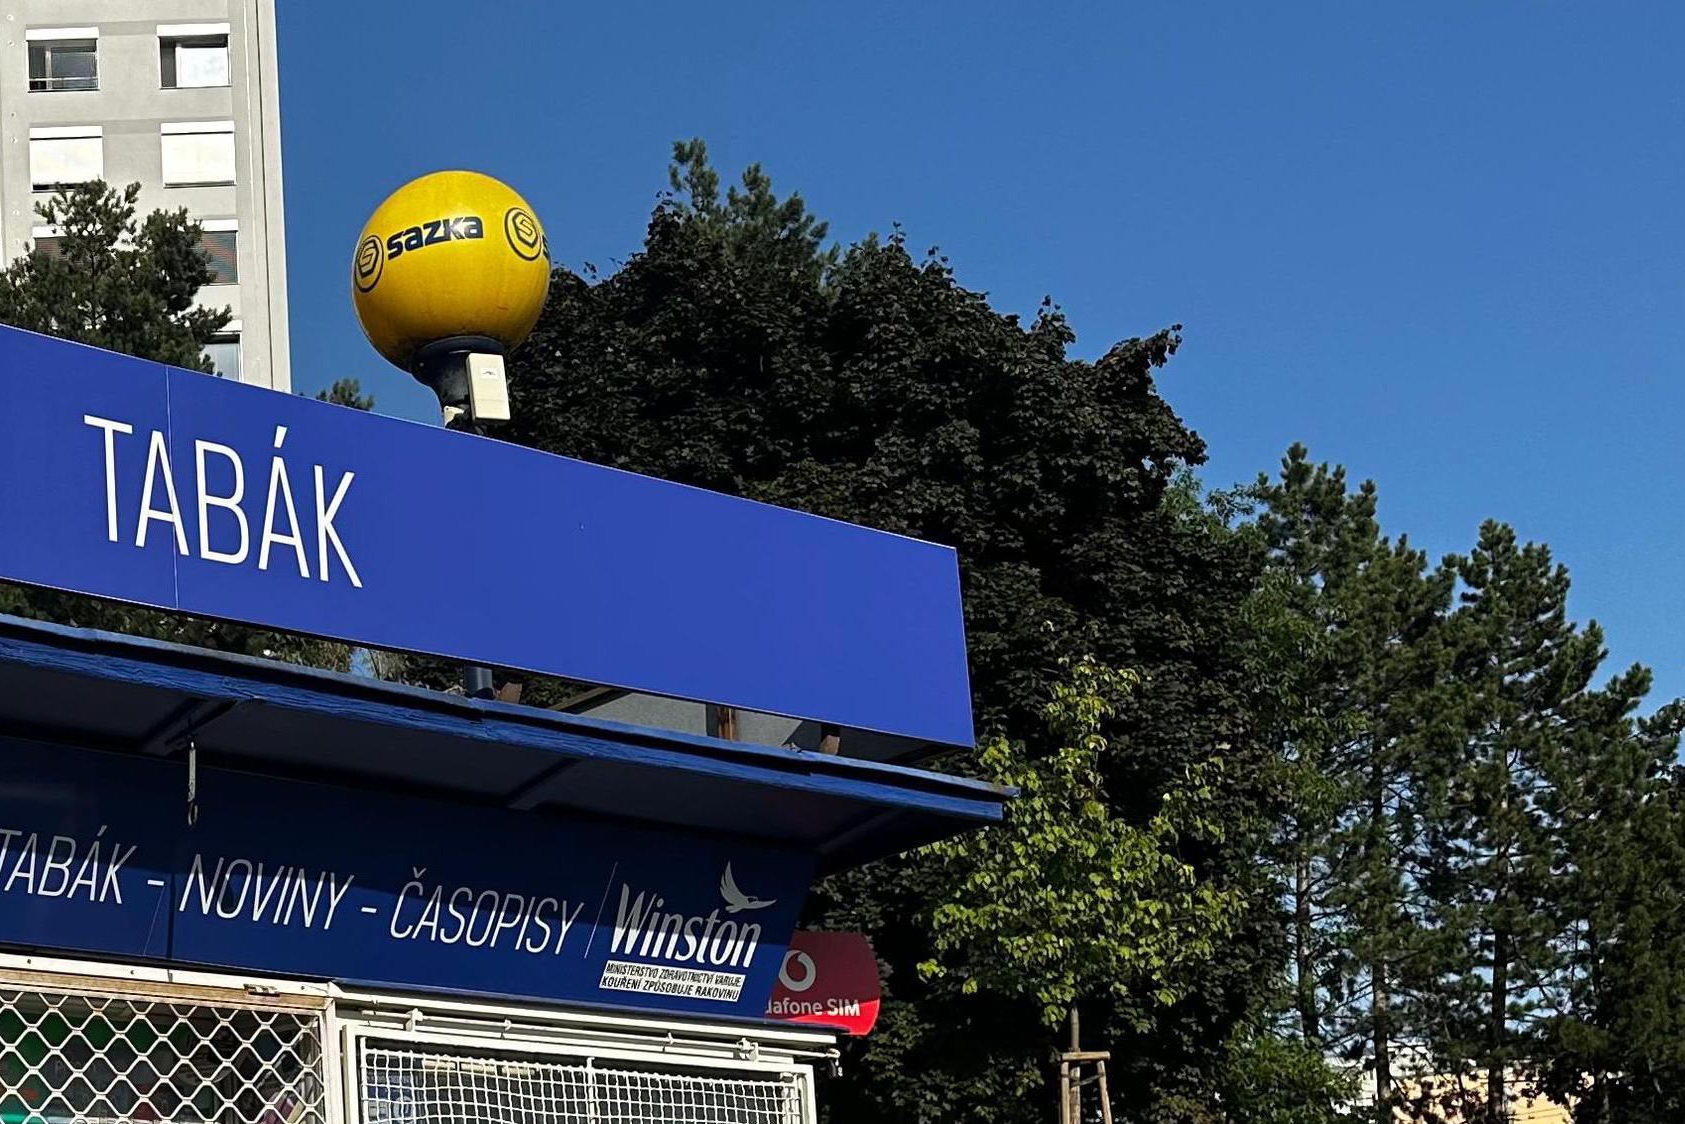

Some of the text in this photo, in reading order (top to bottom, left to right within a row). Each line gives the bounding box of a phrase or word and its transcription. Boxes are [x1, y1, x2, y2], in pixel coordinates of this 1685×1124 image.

[84, 415, 363, 588] TABÁK
[179, 854, 355, 930] NOVINY
[390, 867, 585, 955] ČASOPISY
[610, 883, 762, 968] Winston
[602, 975, 740, 1000] KOUŘENÍ ZPŮSOBUJE RAKOVINU
[606, 963, 659, 978] MINISTERSTVO
[659, 968, 714, 984] ZDRAVOTNICTVÍ
[827, 998, 860, 1016] SIM
